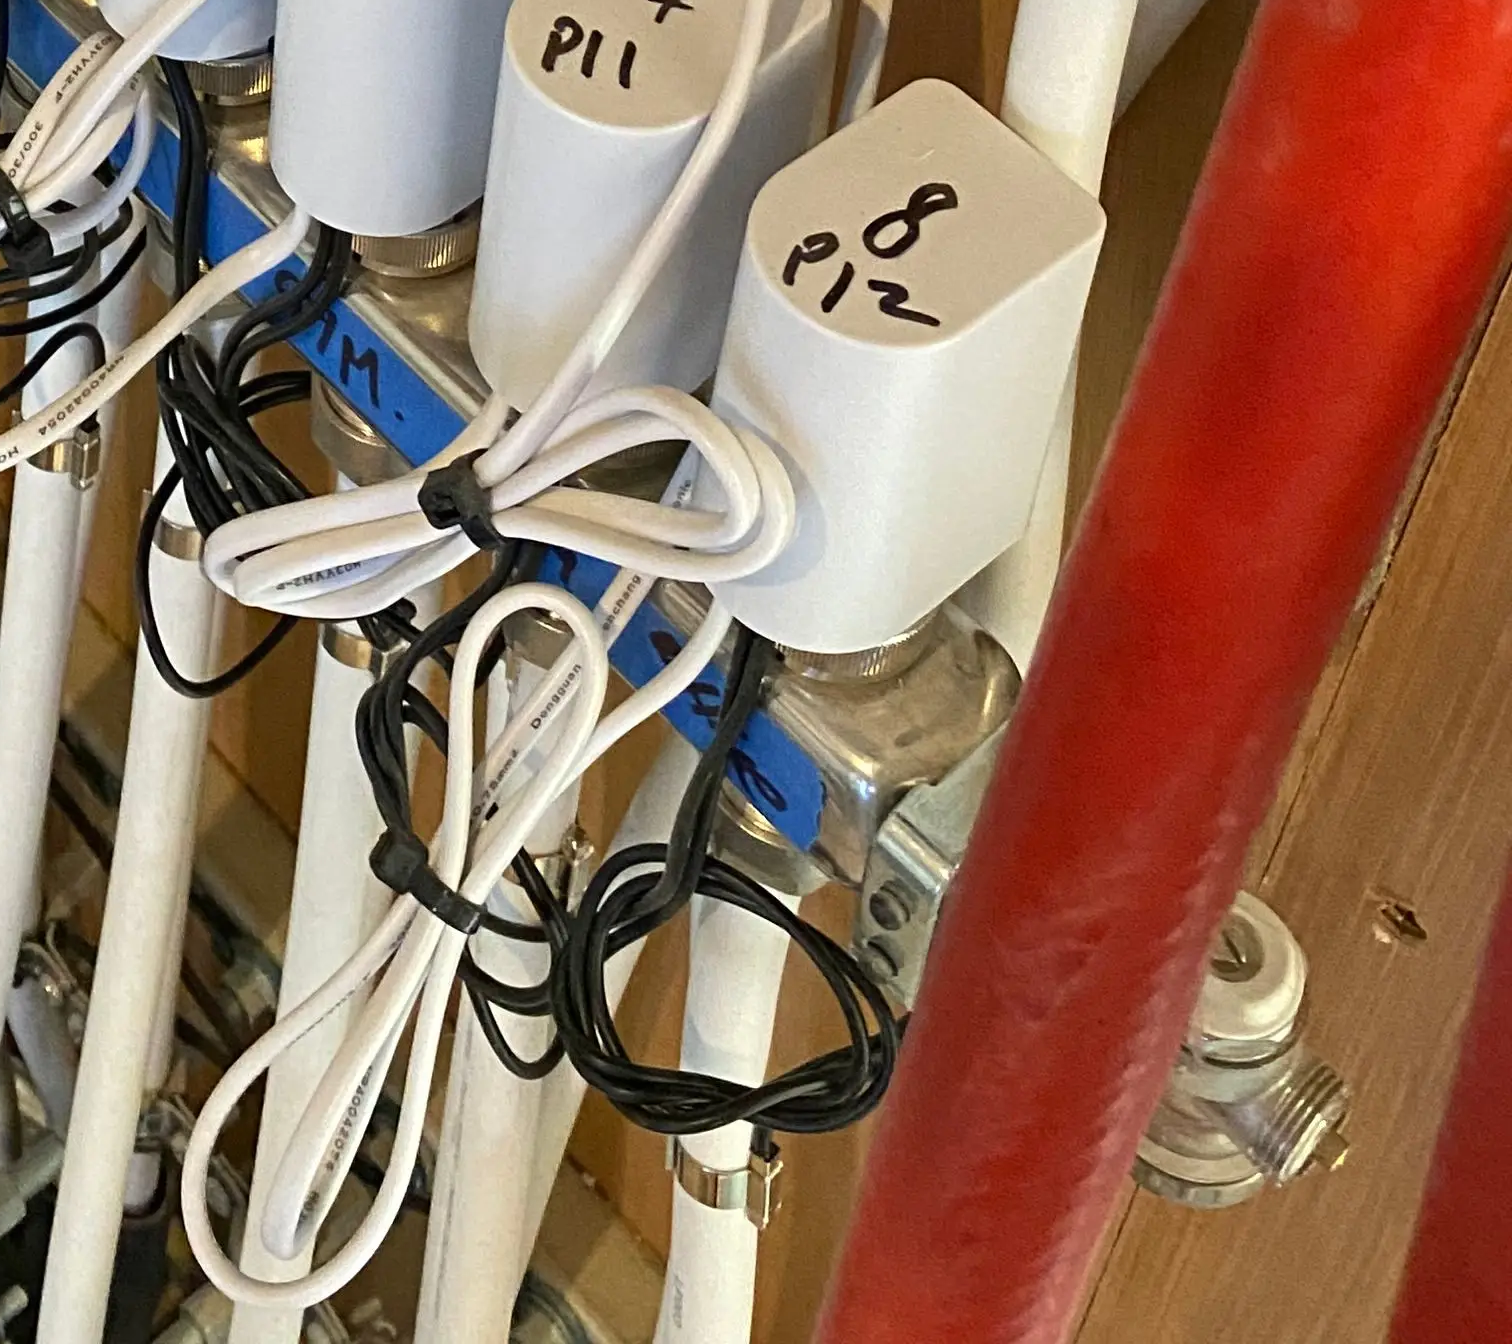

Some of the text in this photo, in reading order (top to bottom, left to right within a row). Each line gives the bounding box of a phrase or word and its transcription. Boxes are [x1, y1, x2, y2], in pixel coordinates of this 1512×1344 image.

[540, 13, 638, 91] P11
[861, 181, 959, 261] 8
[782, 231, 942, 329] P12
[601, 573, 643, 632] enchang
